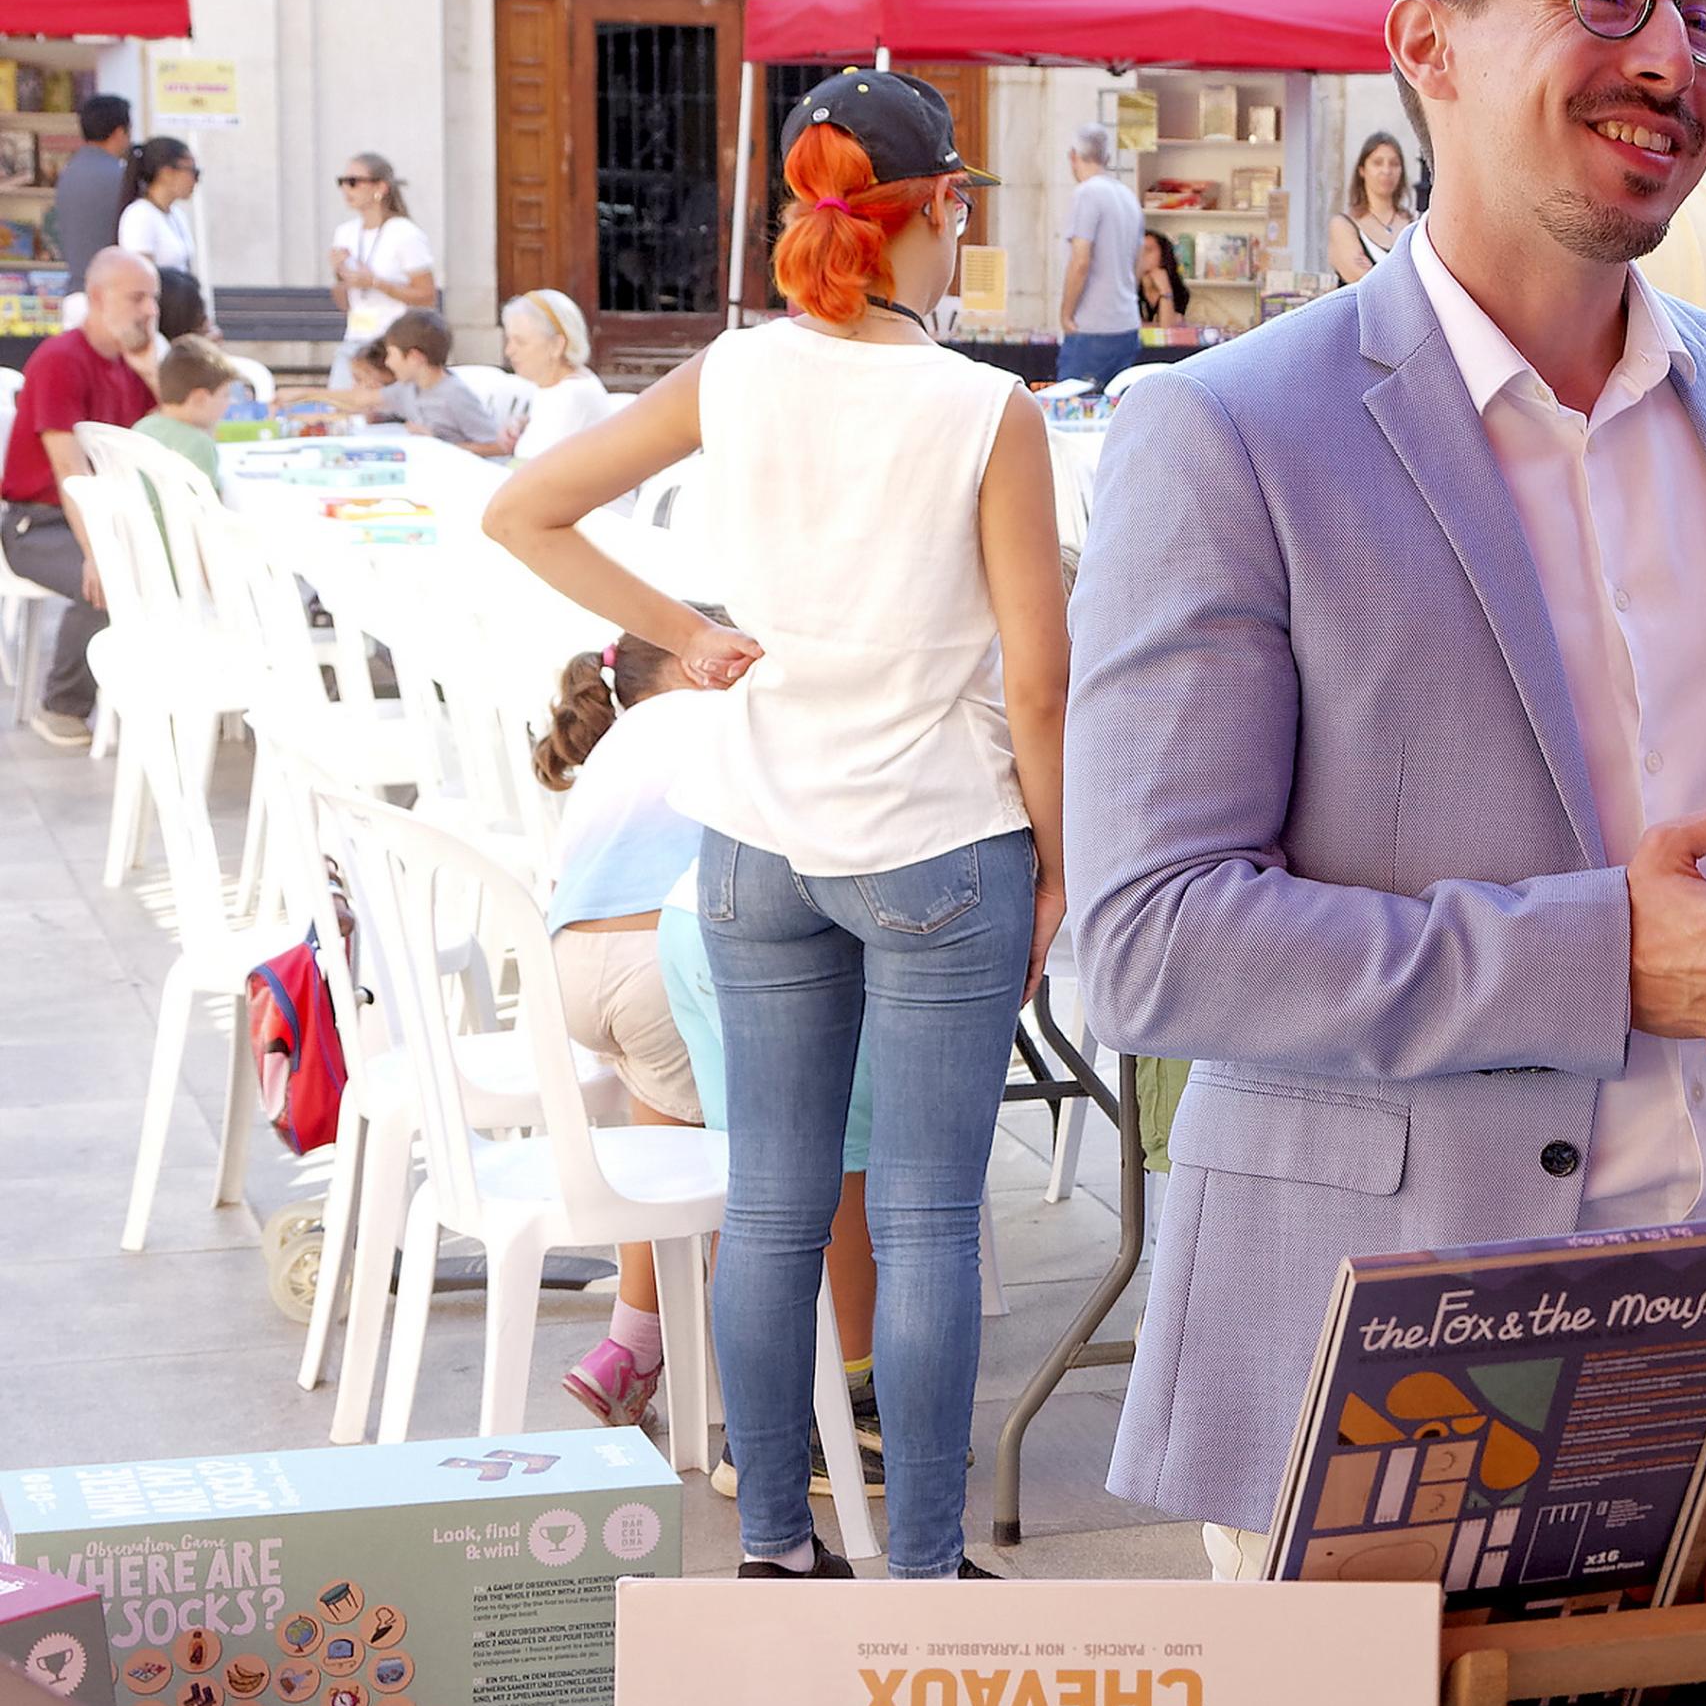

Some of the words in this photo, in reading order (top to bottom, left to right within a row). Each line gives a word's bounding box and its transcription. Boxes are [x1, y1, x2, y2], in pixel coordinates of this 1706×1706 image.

[1359, 1316, 1430, 1352] the
[1428, 1289, 1498, 1348] Fox
[1498, 1310, 1524, 1341] &
[1527, 1292, 1597, 1337] the
[432, 1527, 482, 1544] Look,
[485, 1521, 521, 1541] find
[85, 1536, 178, 1558] Observation
[181, 1533, 228, 1551] Game
[465, 1545, 481, 1560] &
[483, 1541, 520, 1559] win!
[205, 1537, 284, 1591] ARE
[111, 1586, 286, 1649] SOCKS?
[857, 1642, 909, 1660] PARXÍS
[1035, 1642, 1065, 1656] NON
[1083, 1642, 1146, 1660] PARCHÍS
[1163, 1642, 1203, 1657] LUDO
